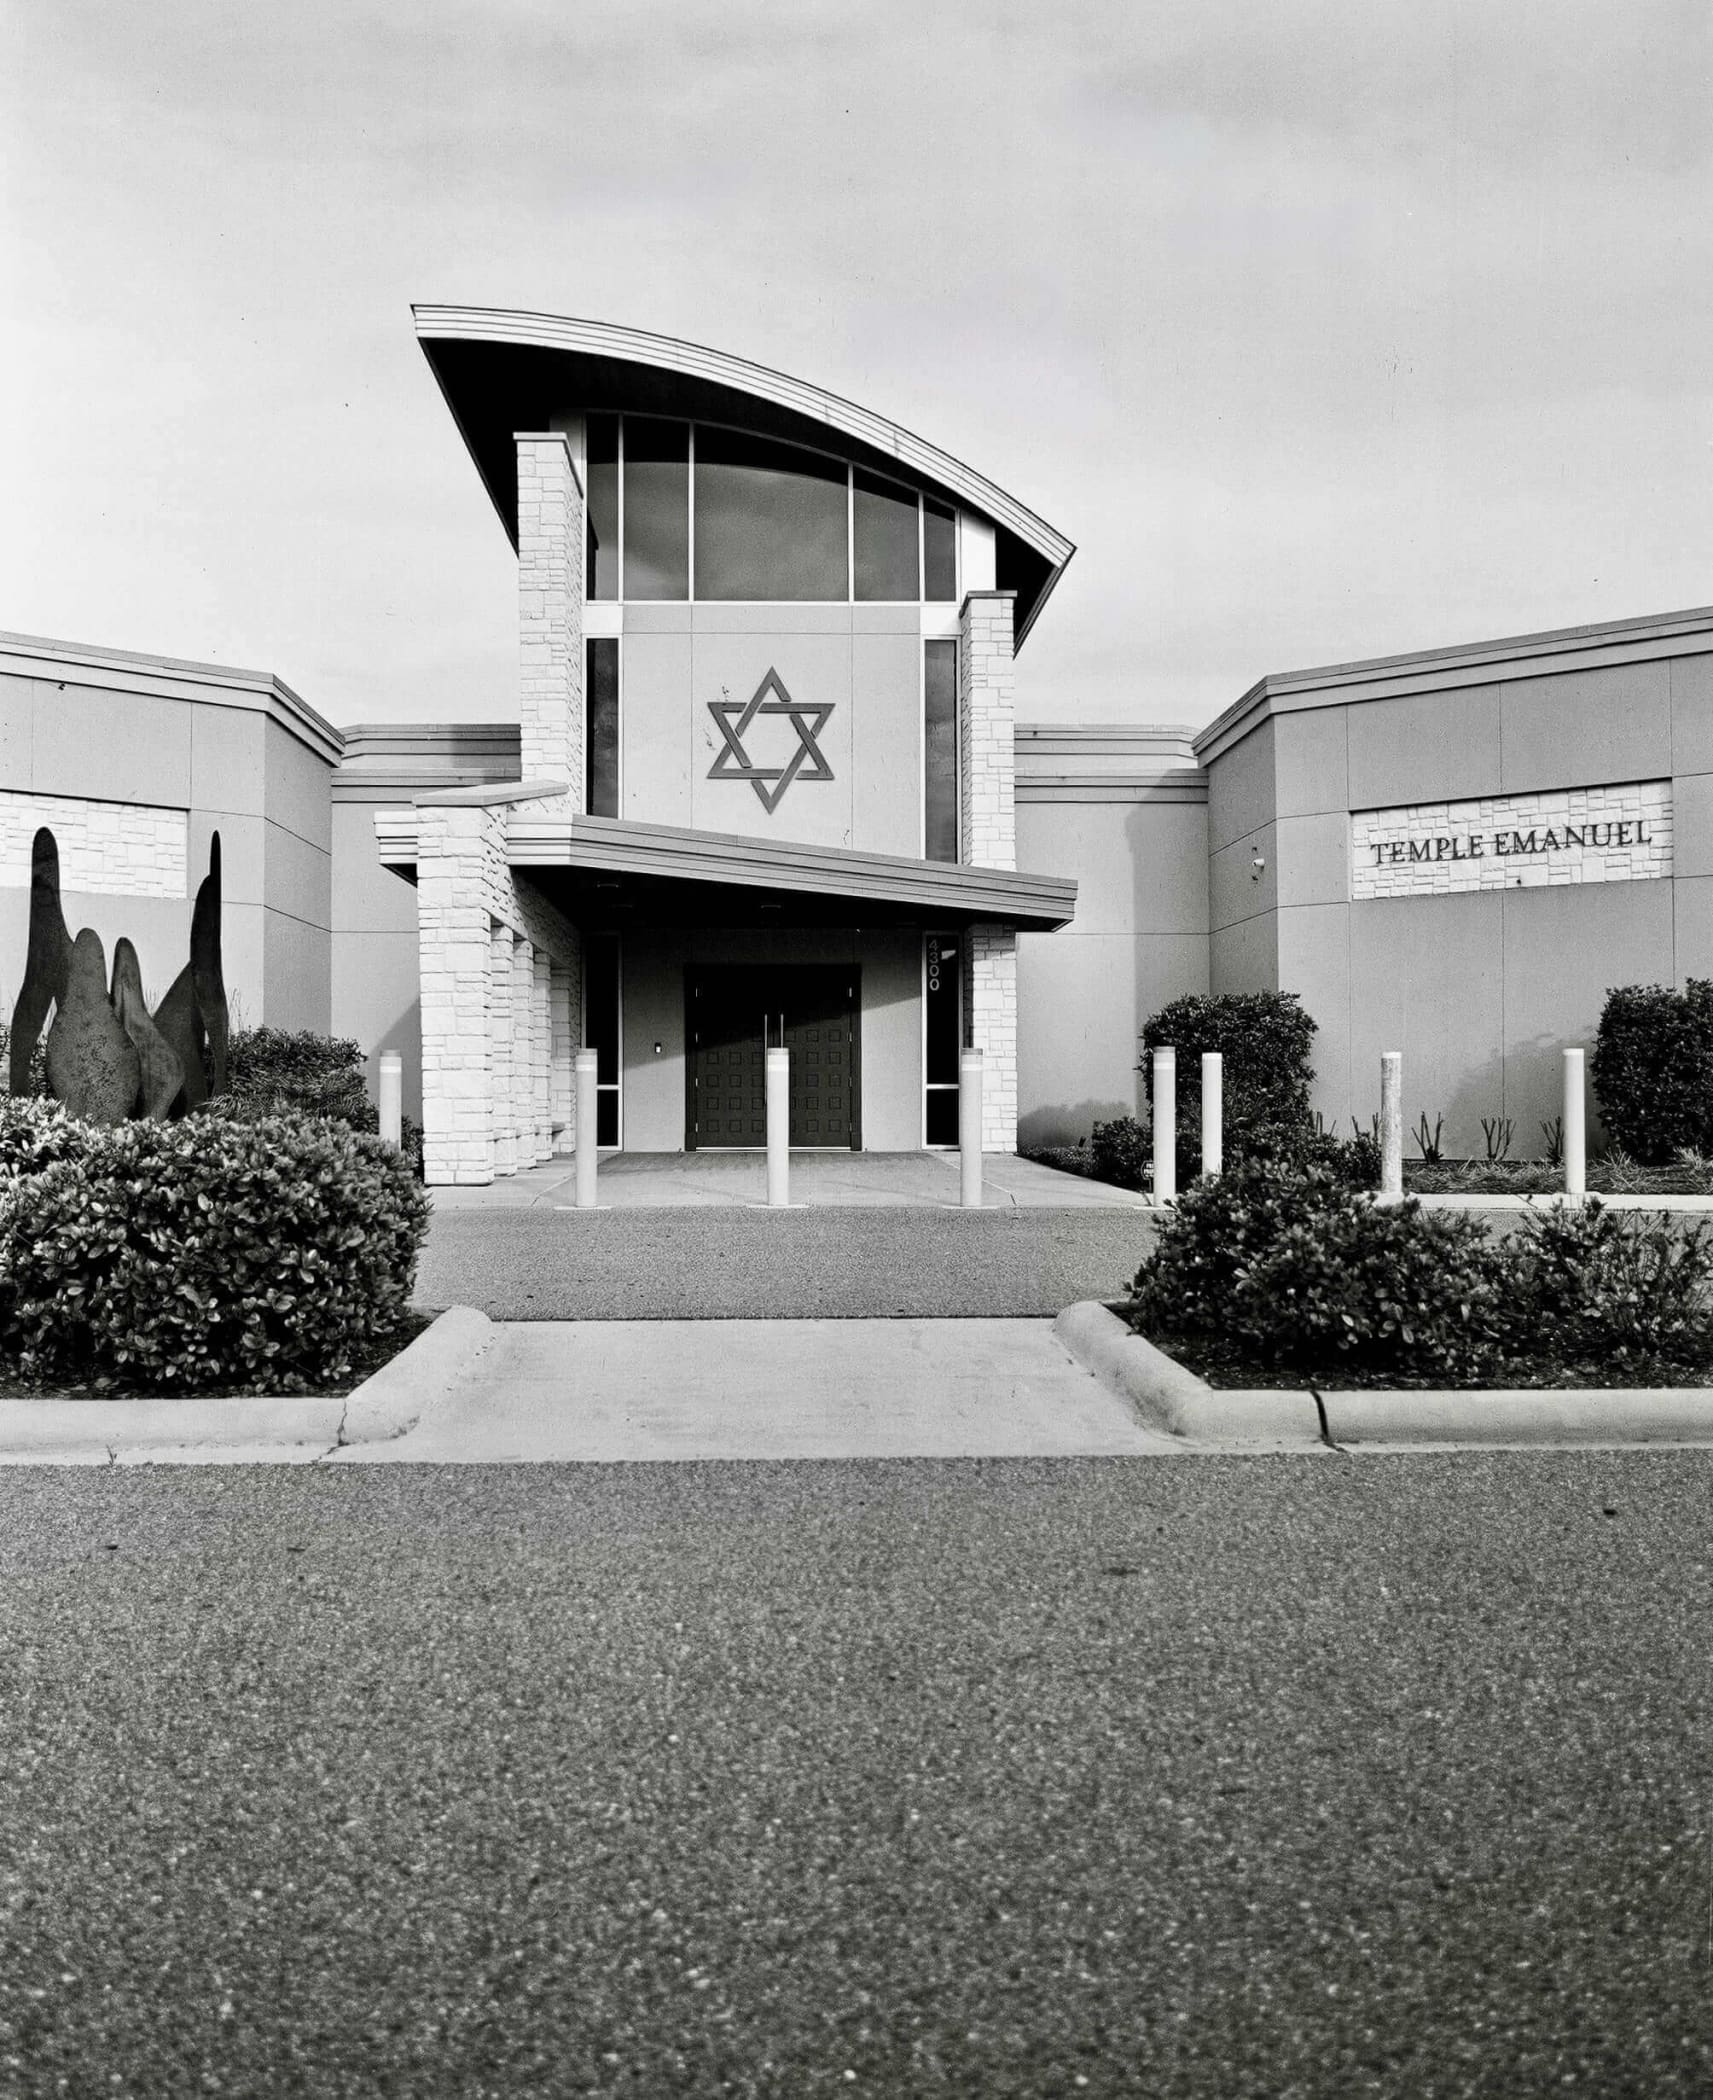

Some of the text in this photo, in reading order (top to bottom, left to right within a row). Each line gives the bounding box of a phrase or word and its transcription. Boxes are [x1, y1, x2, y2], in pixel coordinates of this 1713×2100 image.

[1370, 820, 1652, 864] TEMPLE EMANUEL
[929, 939, 940, 991] 4300
